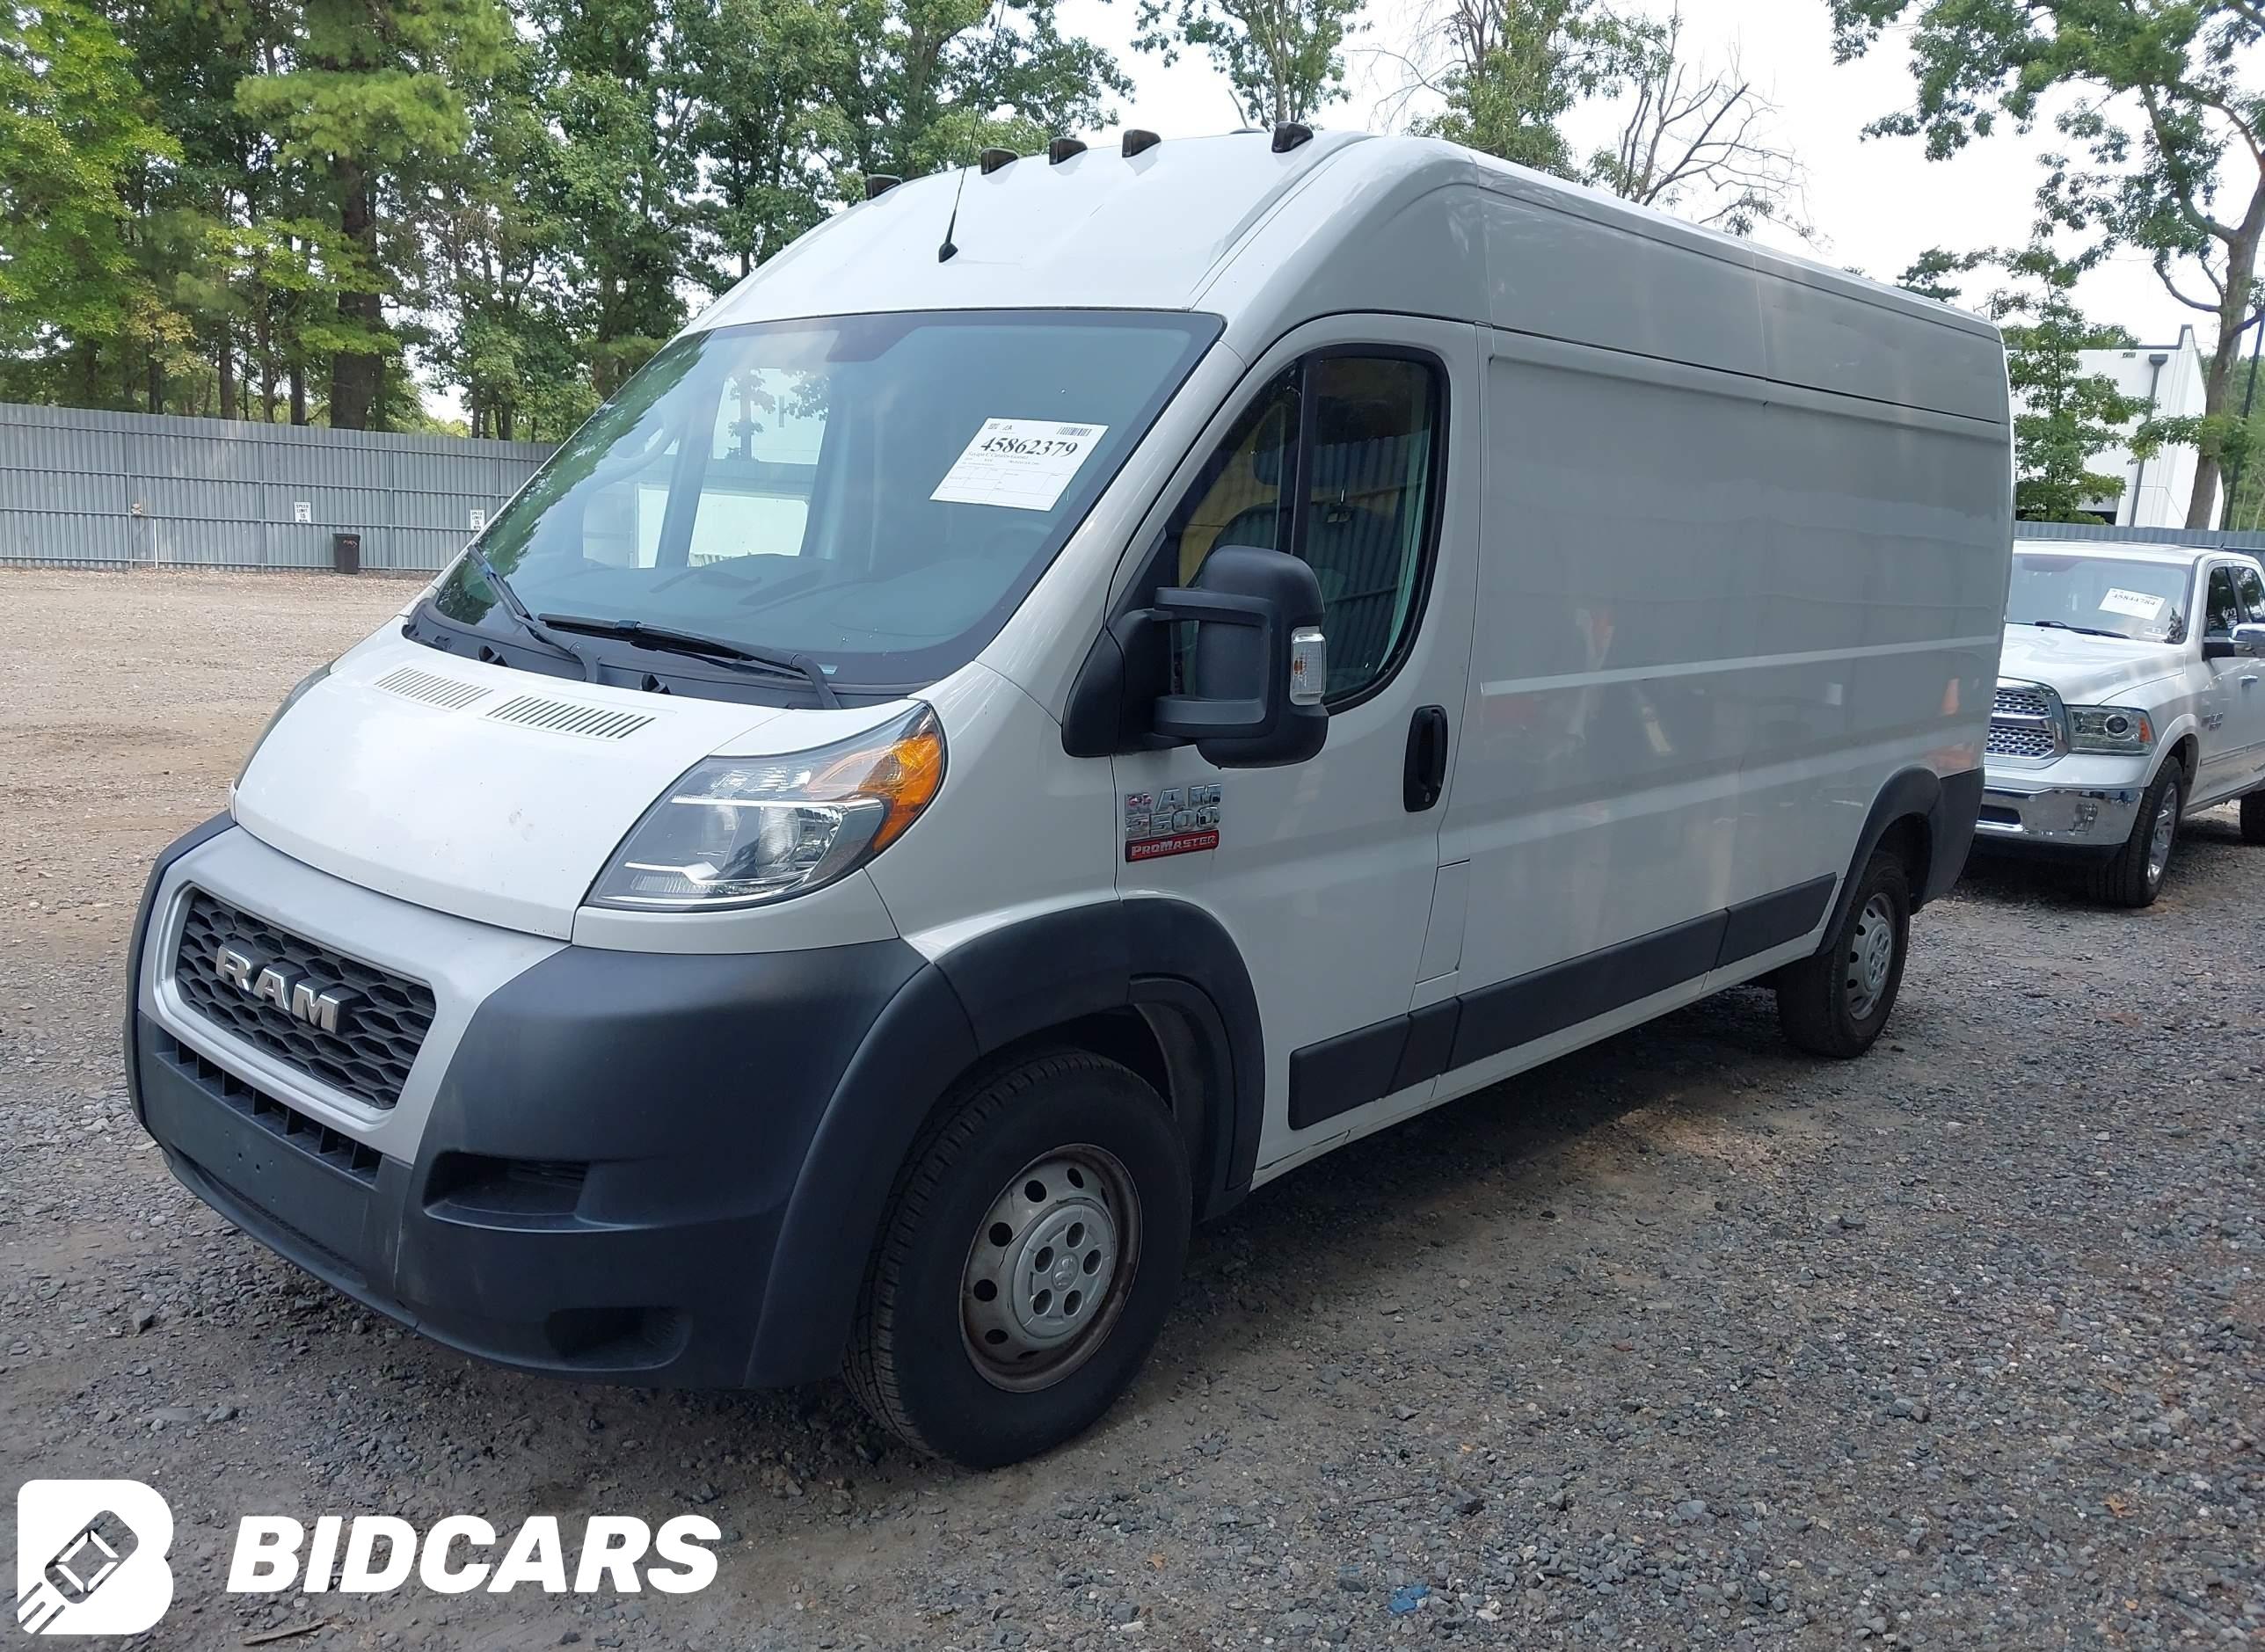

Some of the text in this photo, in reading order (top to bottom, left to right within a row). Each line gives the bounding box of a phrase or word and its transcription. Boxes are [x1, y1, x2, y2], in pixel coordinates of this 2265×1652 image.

[980, 436, 1079, 457] 45862379
[1125, 782, 1222, 814] RAM
[216, 945, 340, 1034] RAM
